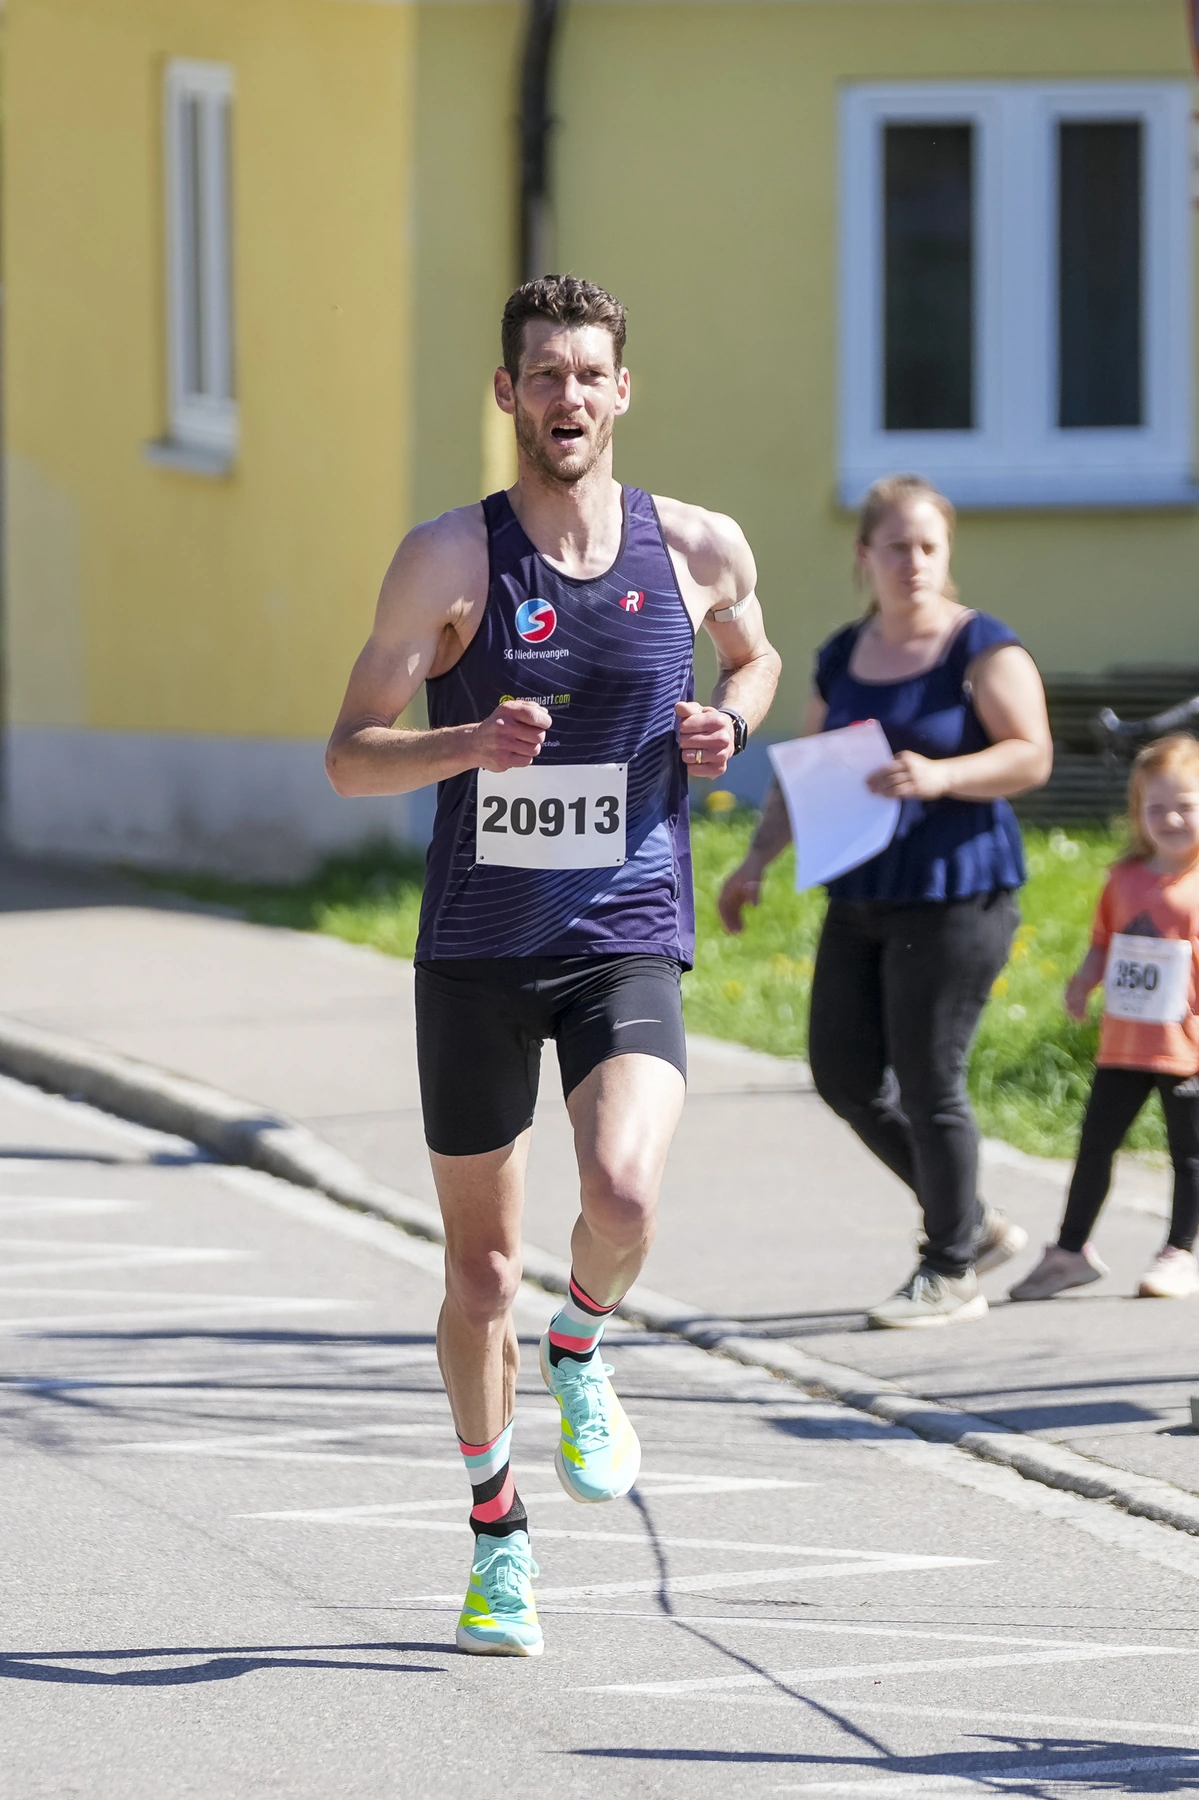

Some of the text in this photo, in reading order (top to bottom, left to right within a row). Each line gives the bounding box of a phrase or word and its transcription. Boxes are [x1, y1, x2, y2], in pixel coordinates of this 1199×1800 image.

[503, 648, 569, 660] SG Niederwangen
[482, 795, 620, 837] 20913
